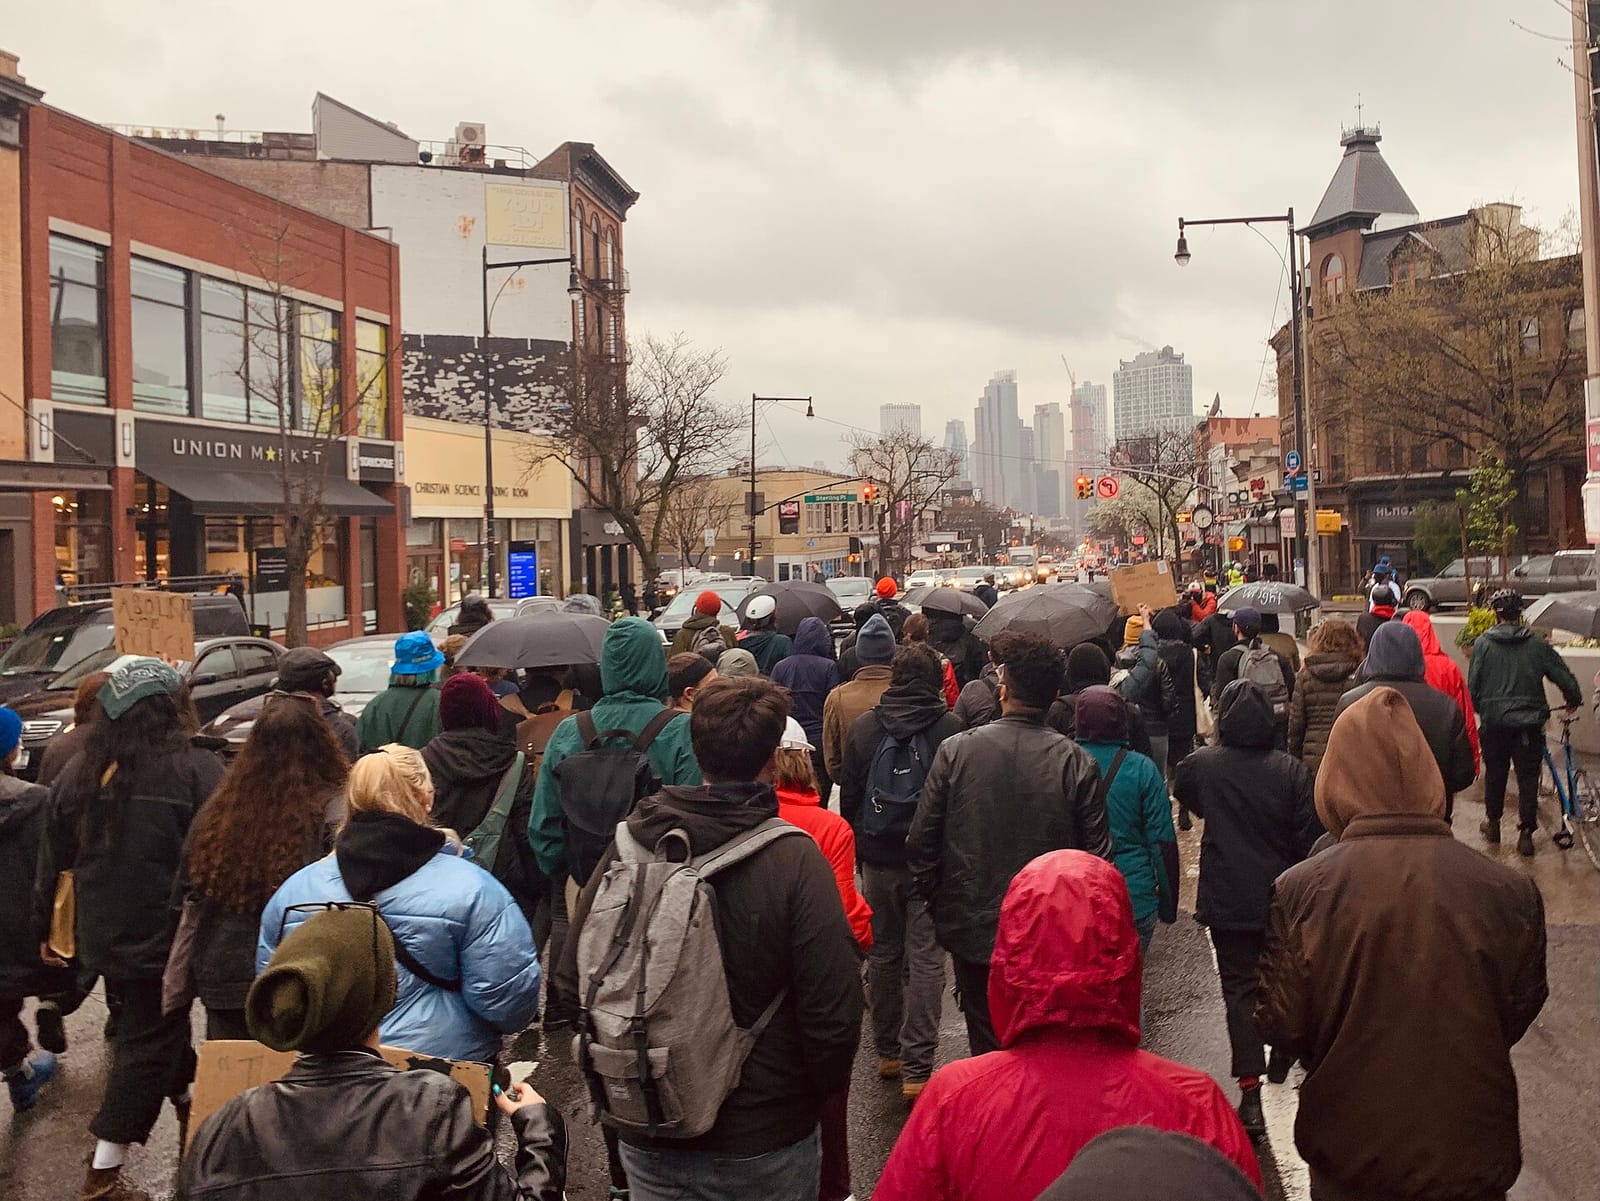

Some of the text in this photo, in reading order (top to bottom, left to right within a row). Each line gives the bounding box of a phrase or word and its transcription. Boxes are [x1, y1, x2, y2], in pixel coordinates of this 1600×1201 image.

[173, 438, 242, 459] UNION
[415, 482, 449, 495] CHRISTIAN
[454, 484, 480, 496] SCIENCE
[512, 487, 528, 498] ROOM
